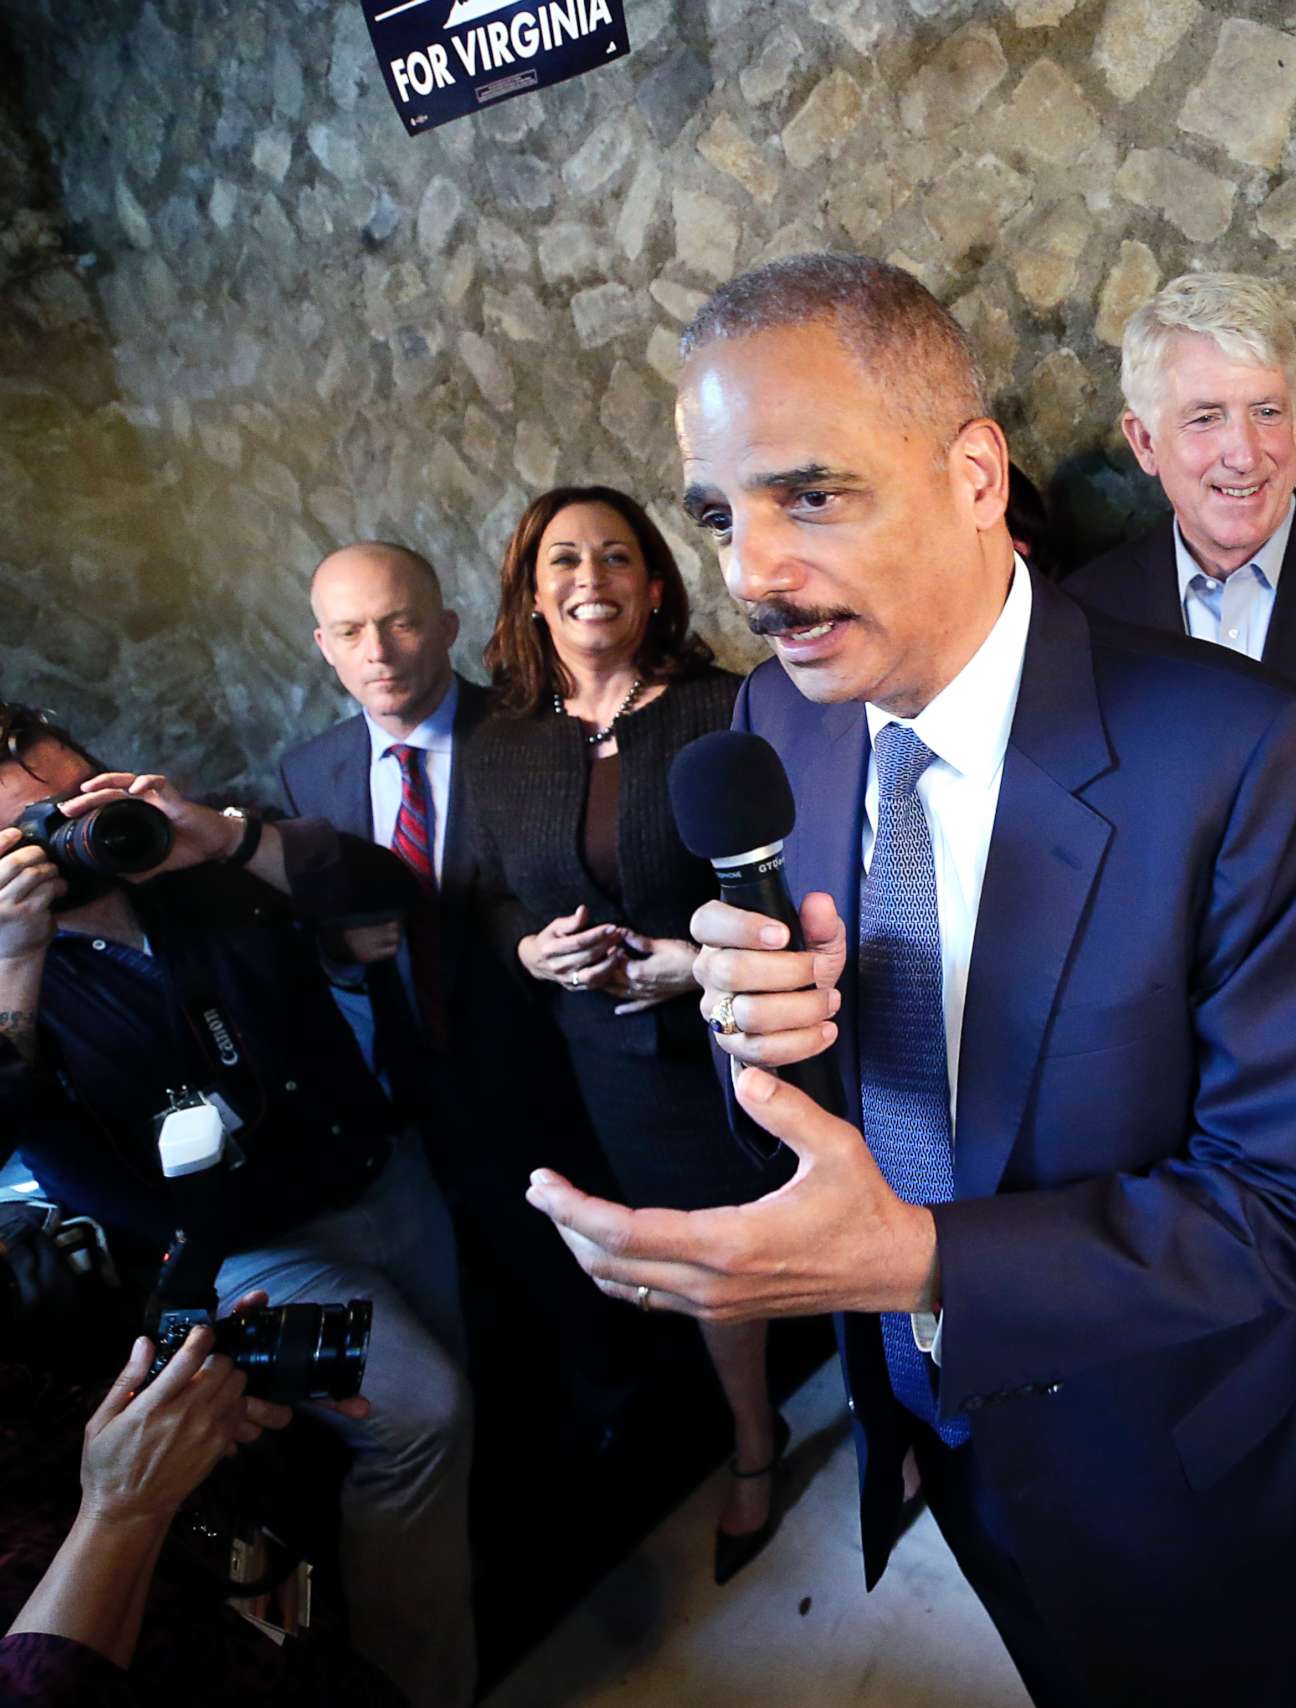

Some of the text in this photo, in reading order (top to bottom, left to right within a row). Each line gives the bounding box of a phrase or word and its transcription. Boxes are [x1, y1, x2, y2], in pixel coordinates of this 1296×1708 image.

[390, 44, 455, 102] FOR
[451, 0, 612, 76] VIRGINIA
[203, 1008, 238, 1066] Canon
